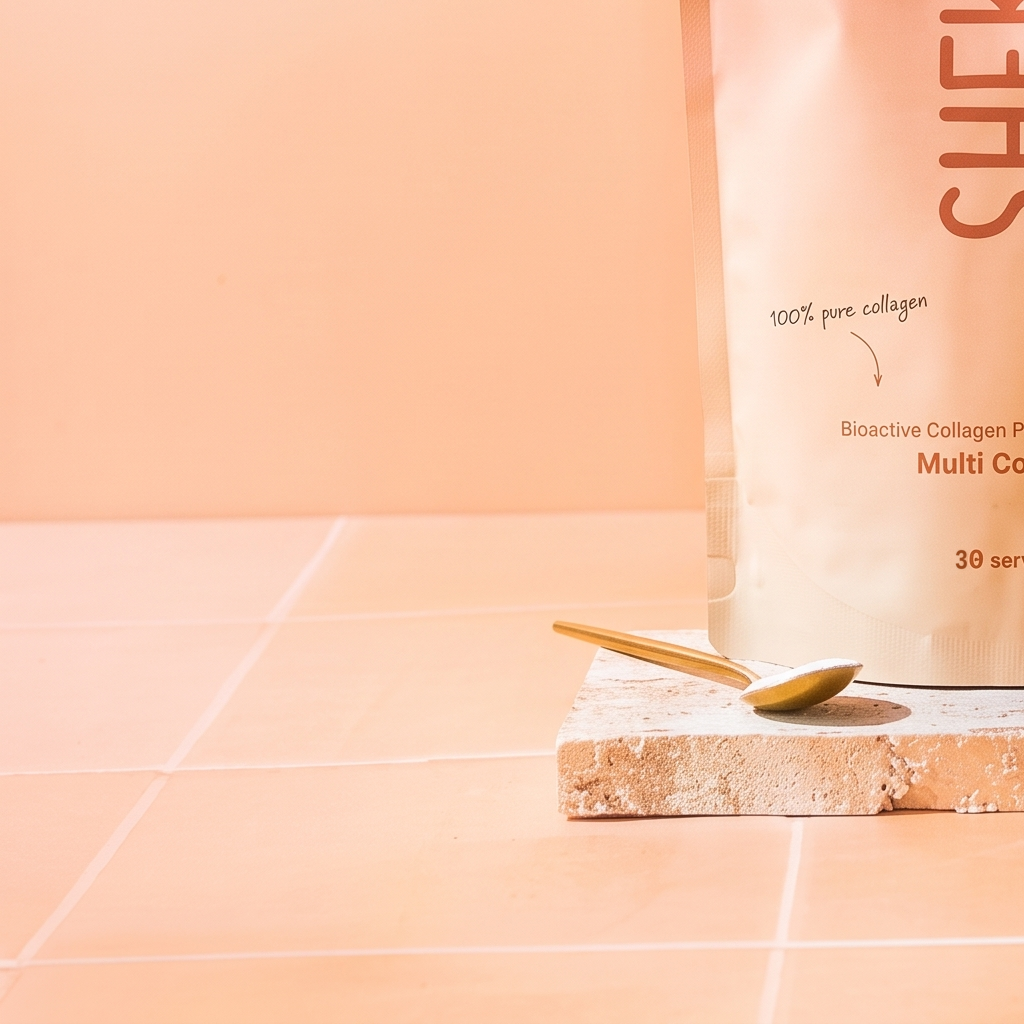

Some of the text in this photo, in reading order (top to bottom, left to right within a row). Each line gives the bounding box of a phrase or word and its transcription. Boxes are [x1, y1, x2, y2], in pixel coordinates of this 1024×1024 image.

[770, 293, 928, 330] 100% pure collagen
[841, 420, 921, 438] Bioactive
[927, 421, 1006, 443] Collagen
[917, 451, 983, 474] Multi
[955, 549, 984, 569] 30
